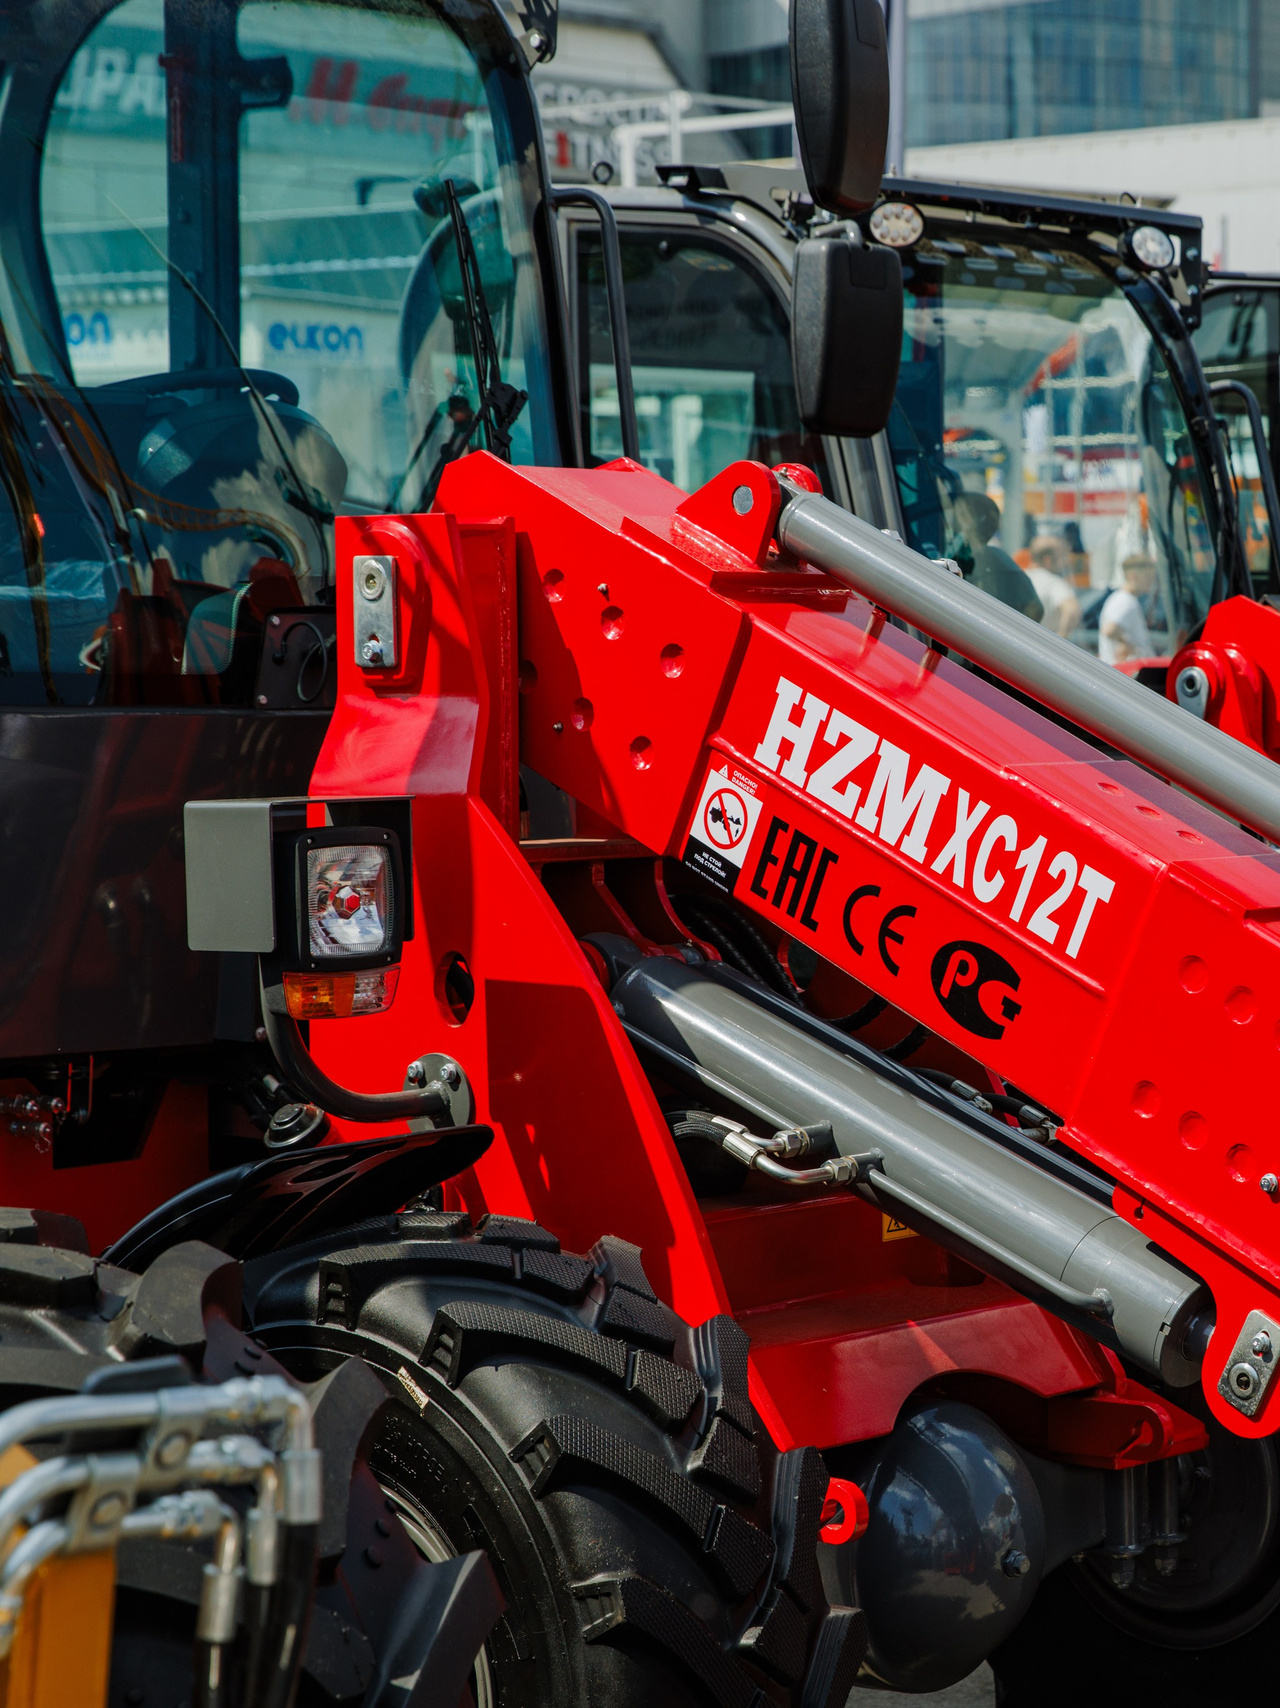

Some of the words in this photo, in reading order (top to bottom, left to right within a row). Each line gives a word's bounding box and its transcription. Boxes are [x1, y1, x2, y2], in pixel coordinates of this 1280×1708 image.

[731, 777, 756, 796] DANGER!
[733, 769, 759, 789] ОПАСНО!
[753, 675, 951, 864] HZM
[930, 787, 1116, 959] XC12T
[694, 853, 705, 865] ПОД
[702, 851, 710, 860] НЕ
[709, 856, 722, 868] СТОЙ
[843, 884, 917, 977] CE
